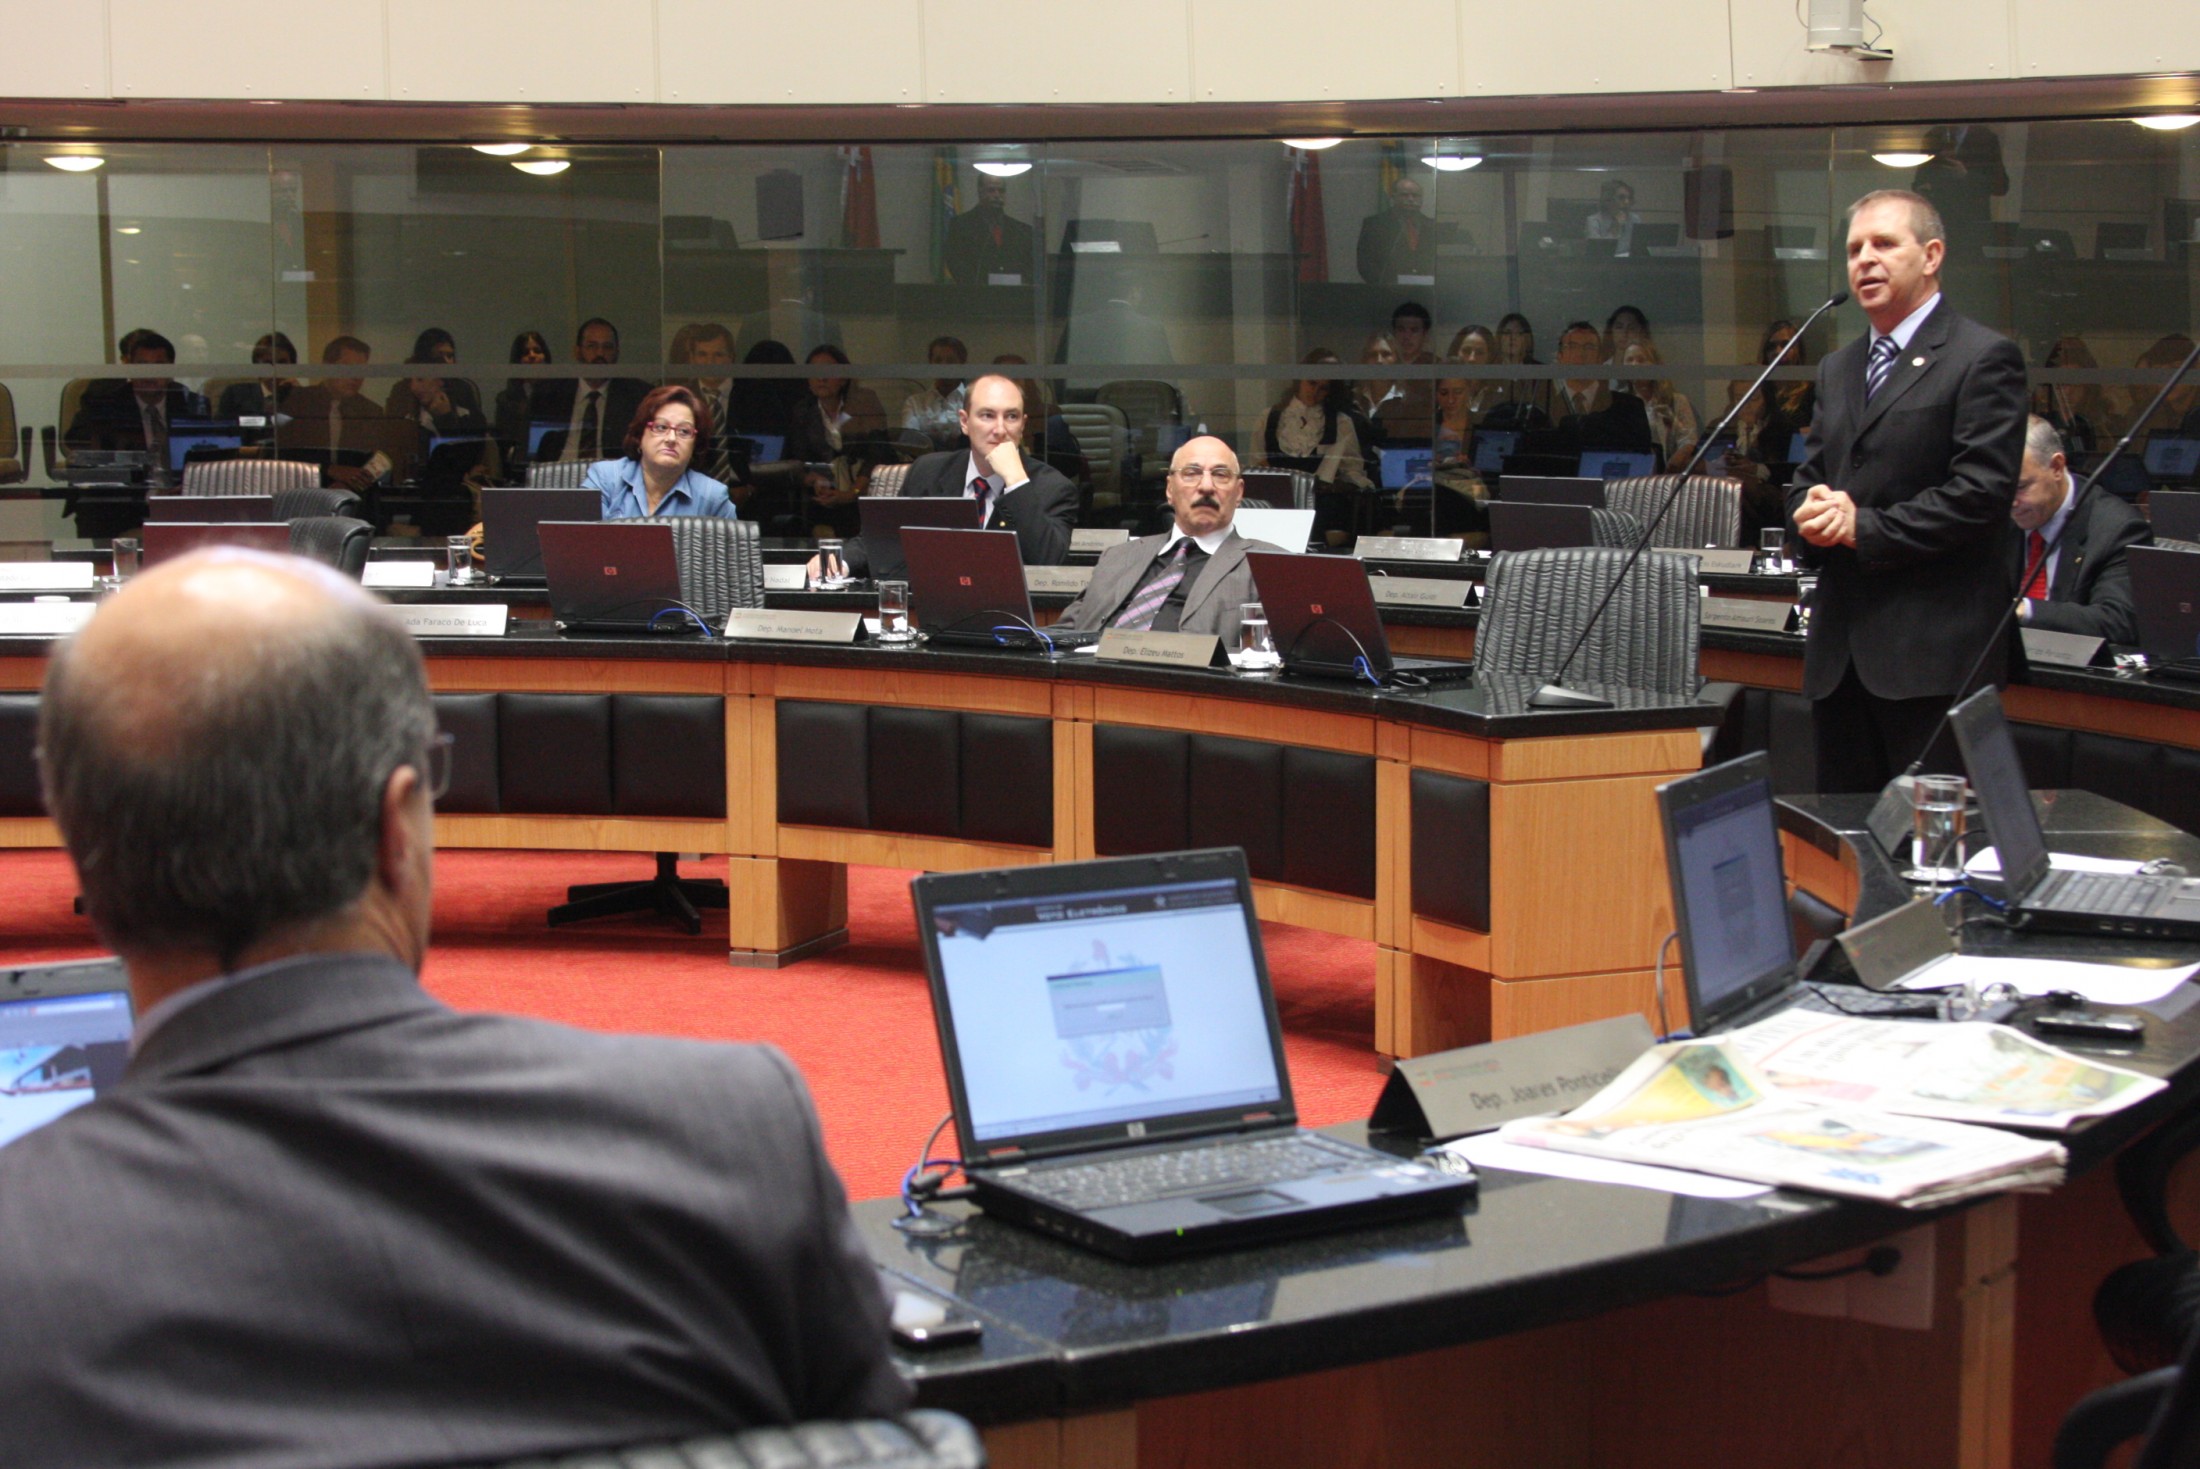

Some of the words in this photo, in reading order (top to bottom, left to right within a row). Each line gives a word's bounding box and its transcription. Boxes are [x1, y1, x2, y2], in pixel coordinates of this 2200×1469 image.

[423, 618, 452, 626] Faraco
[454, 618, 465, 626] De
[467, 618, 487, 626] Luca
[757, 624, 774, 634] Dep.
[776, 626, 802, 634] Manoel
[1122, 646, 1137, 656] Dep.
[1139, 647, 1161, 657] Elizeu
[1162, 649, 1185, 659] Mattos
[1469, 1091, 1507, 1110] Dep.
[1510, 1082, 1558, 1103] Joares
